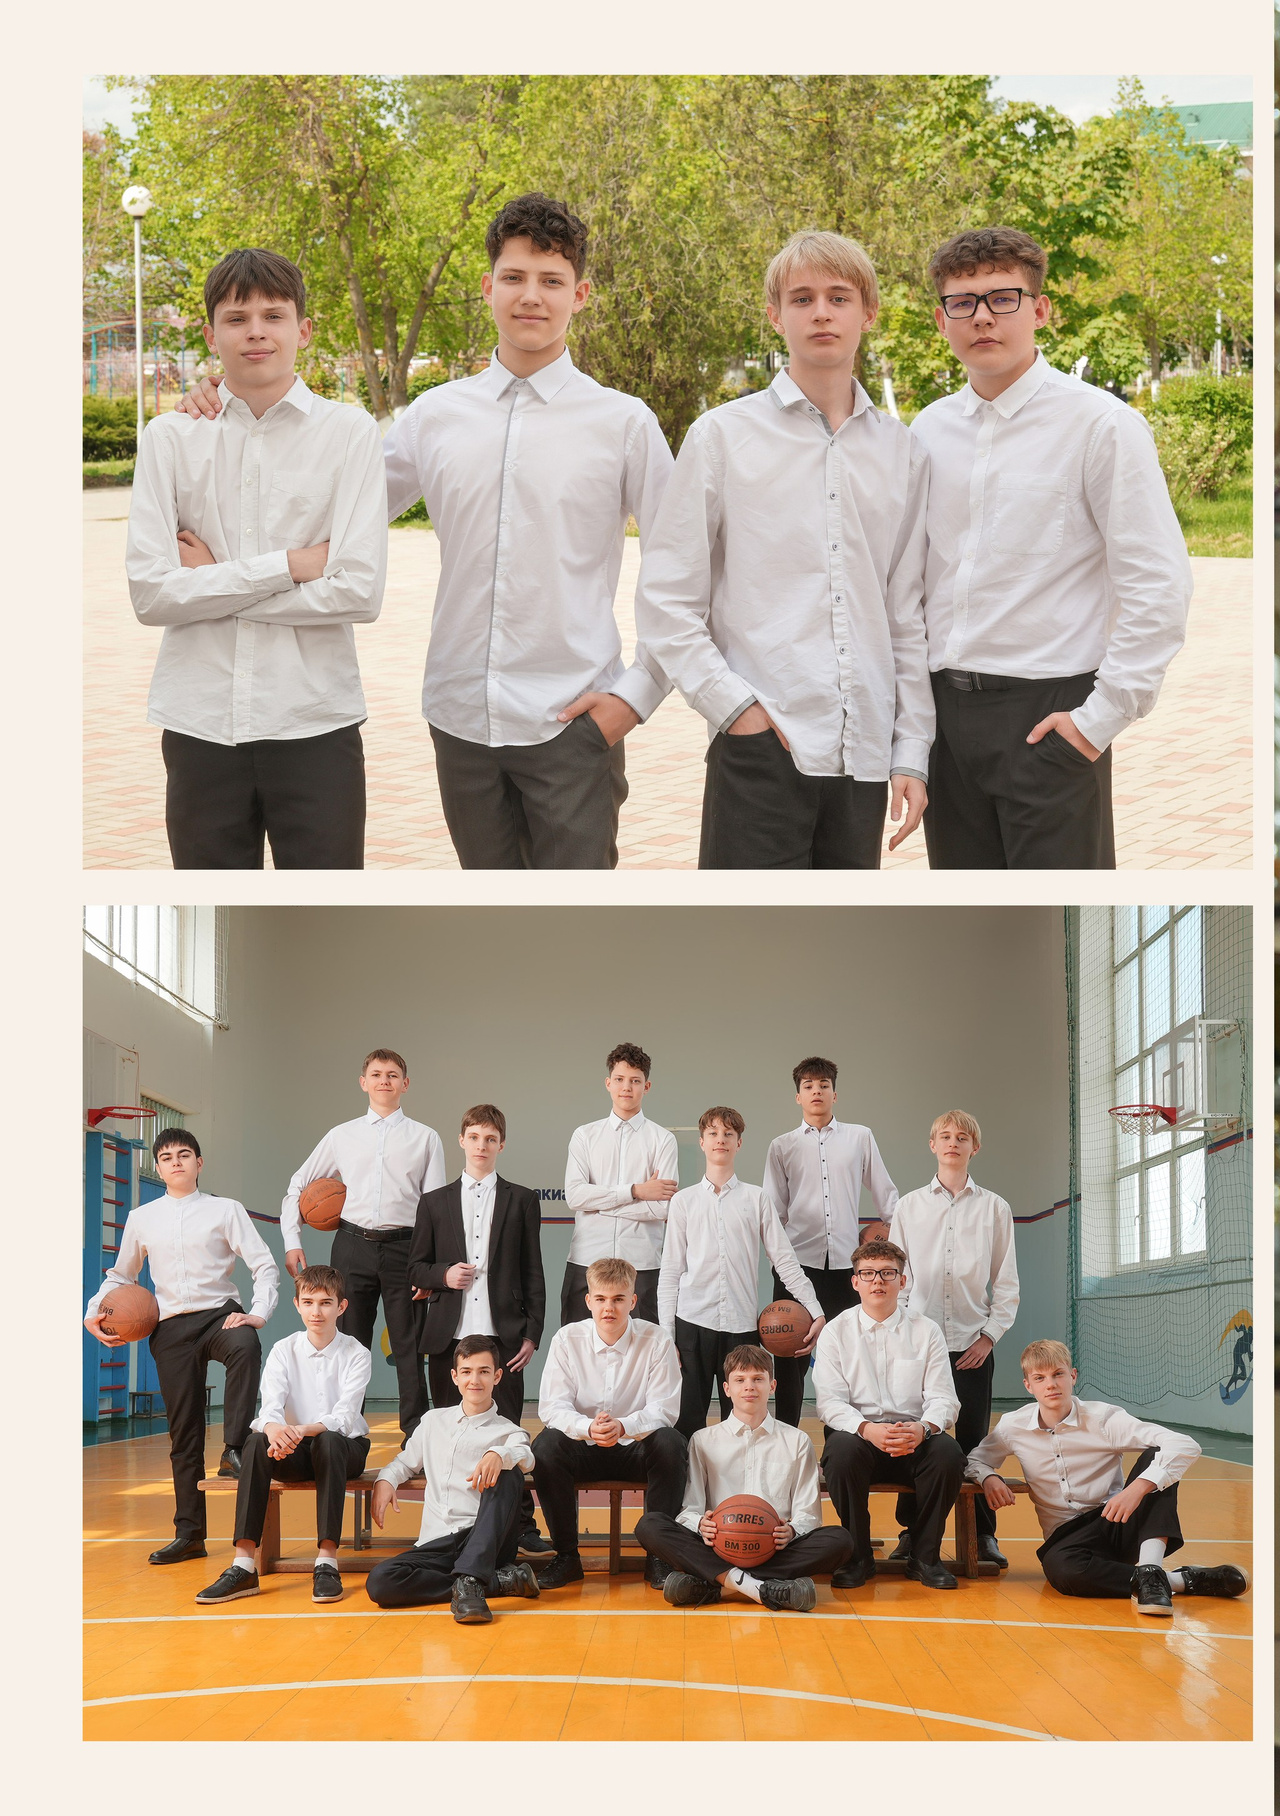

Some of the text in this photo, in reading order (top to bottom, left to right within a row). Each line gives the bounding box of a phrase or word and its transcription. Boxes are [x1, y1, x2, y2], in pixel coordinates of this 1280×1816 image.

[760, 1324, 795, 1334] TORRES
[722, 1513, 765, 1525] TORRES
[725, 1540, 760, 1551] BM 300
